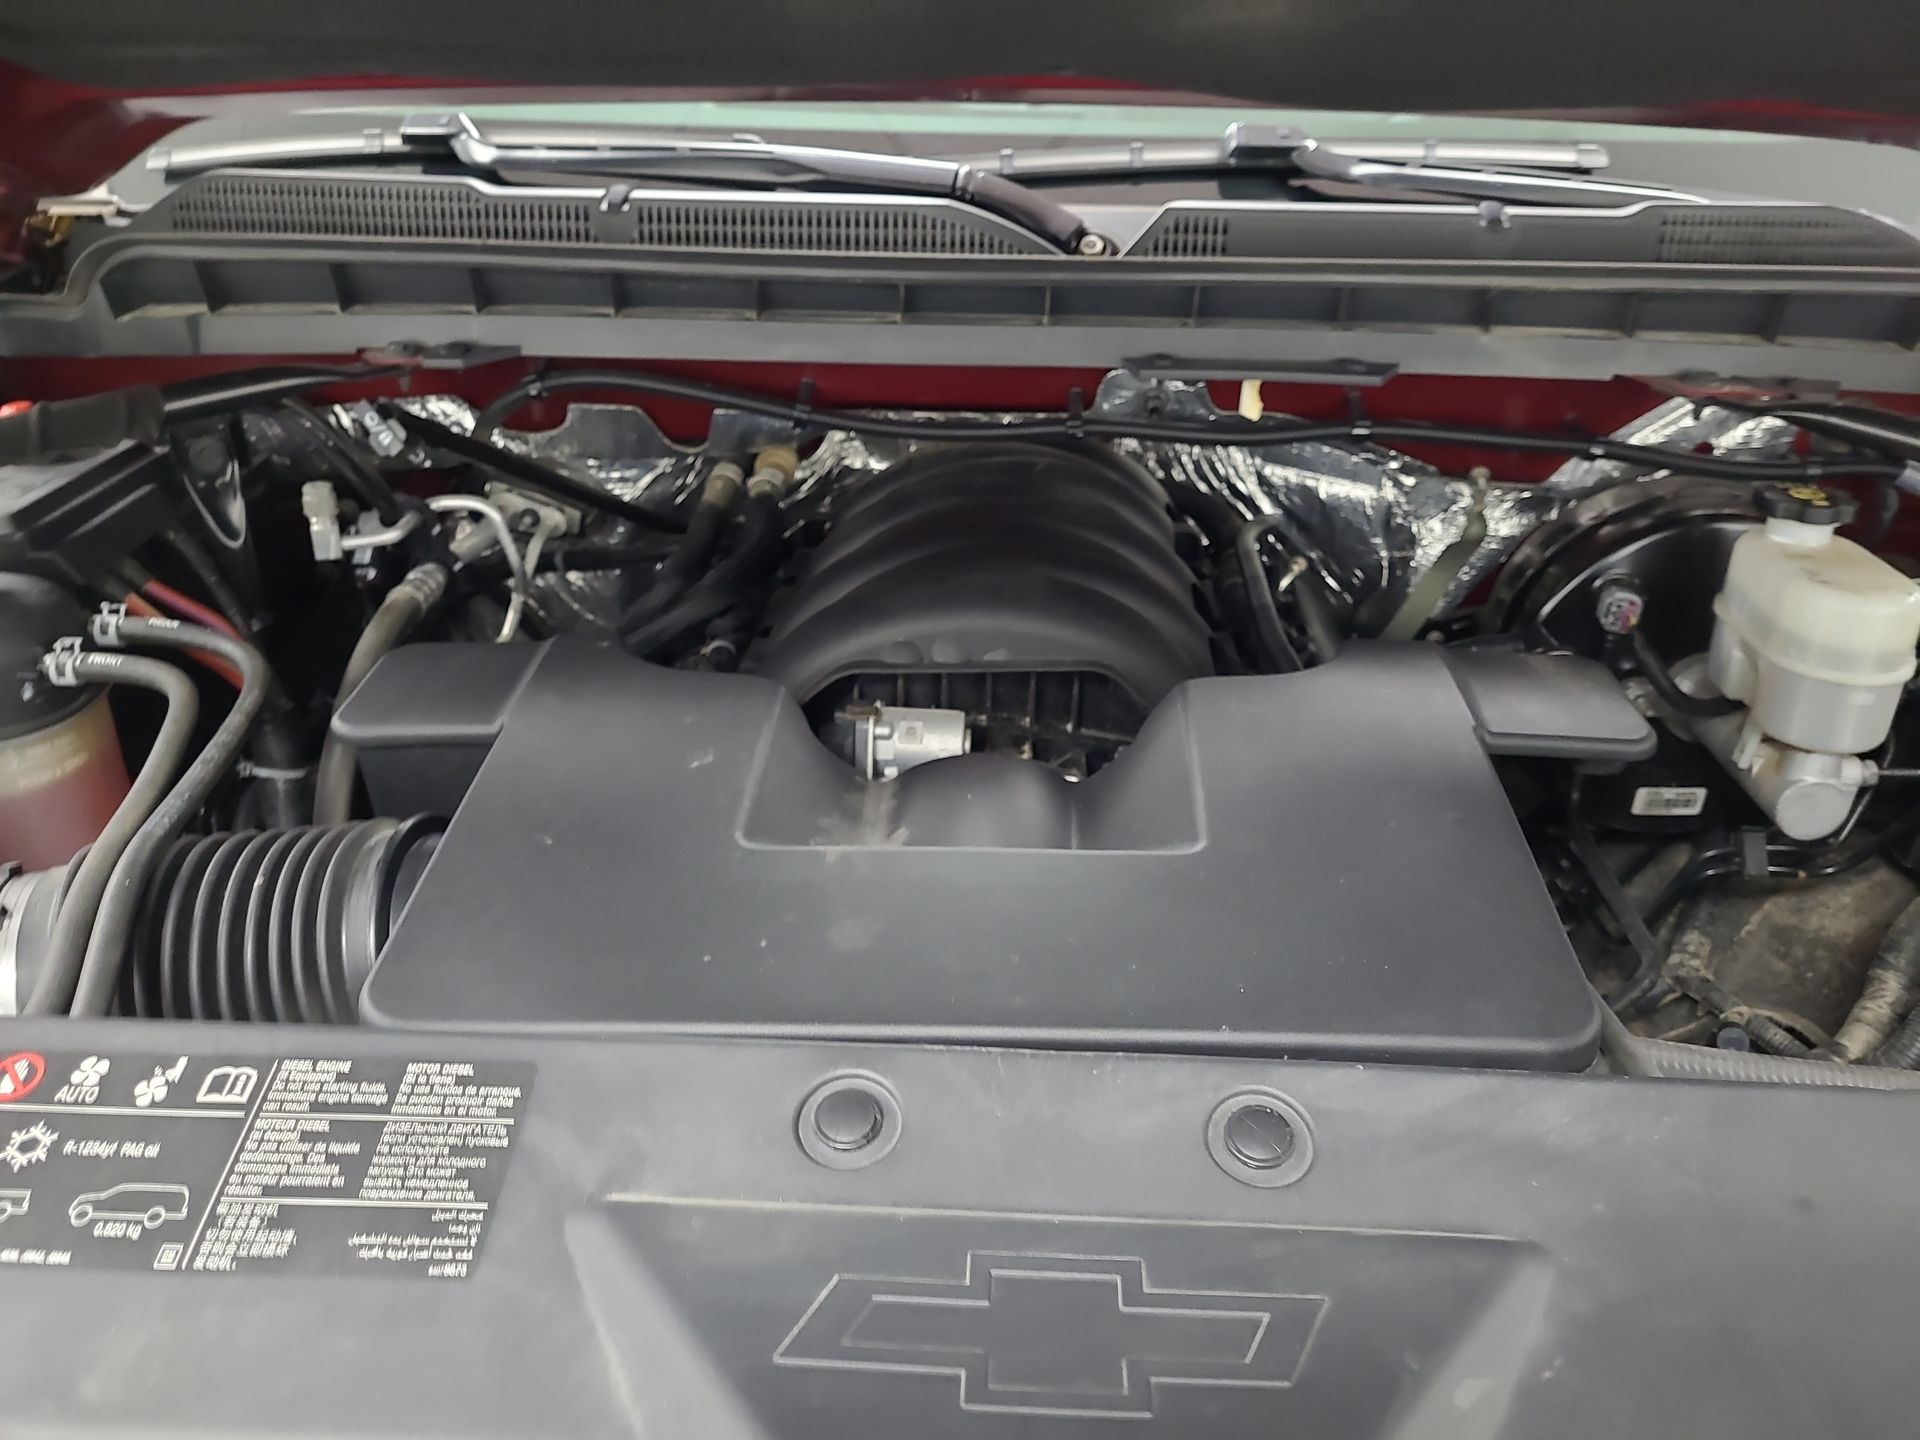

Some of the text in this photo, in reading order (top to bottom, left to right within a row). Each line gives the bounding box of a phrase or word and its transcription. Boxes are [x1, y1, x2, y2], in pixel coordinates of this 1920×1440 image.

[87, 654, 123, 667] FRONT
[281, 1059, 352, 1073] DIESEL ENGINE
[406, 1062, 474, 1076] MOTOR DIESEL
[272, 1081, 285, 1091] Do
[287, 1081, 302, 1092] not
[304, 1082, 320, 1093] use
[322, 1081, 358, 1094] starting
[414, 1085, 430, 1095] use
[433, 1084, 463, 1096] fluidos
[465, 1085, 477, 1096] de
[54, 1085, 100, 1104] AUTO
[318, 1092, 349, 1105] engine
[351, 1092, 388, 1106] damage
[408, 1094, 443, 1106] pueden
[262, 1102, 281, 1111] can
[444, 1106, 455, 1116] en
[254, 1119, 330, 1132] MOTEUR DIESEL
[383, 1121, 507, 1137] ДИЗЕЛЬНЫЙ ДВИГАТЕЛЬ
[121, 1141, 145, 1158] PAG
[314, 1142, 327, 1153] de
[234, 1162, 288, 1175] dommages
[416, 1157, 435, 1167] для
[437, 1157, 486, 1169] холодного
[406, 1165, 424, 1177] Это
[426, 1167, 457, 1178] может
[244, 1174, 279, 1186] moteur
[280, 1175, 331, 1188] pourraient
[332, 1176, 345, 1188] en
[126, 1221, 142, 1240] kg
